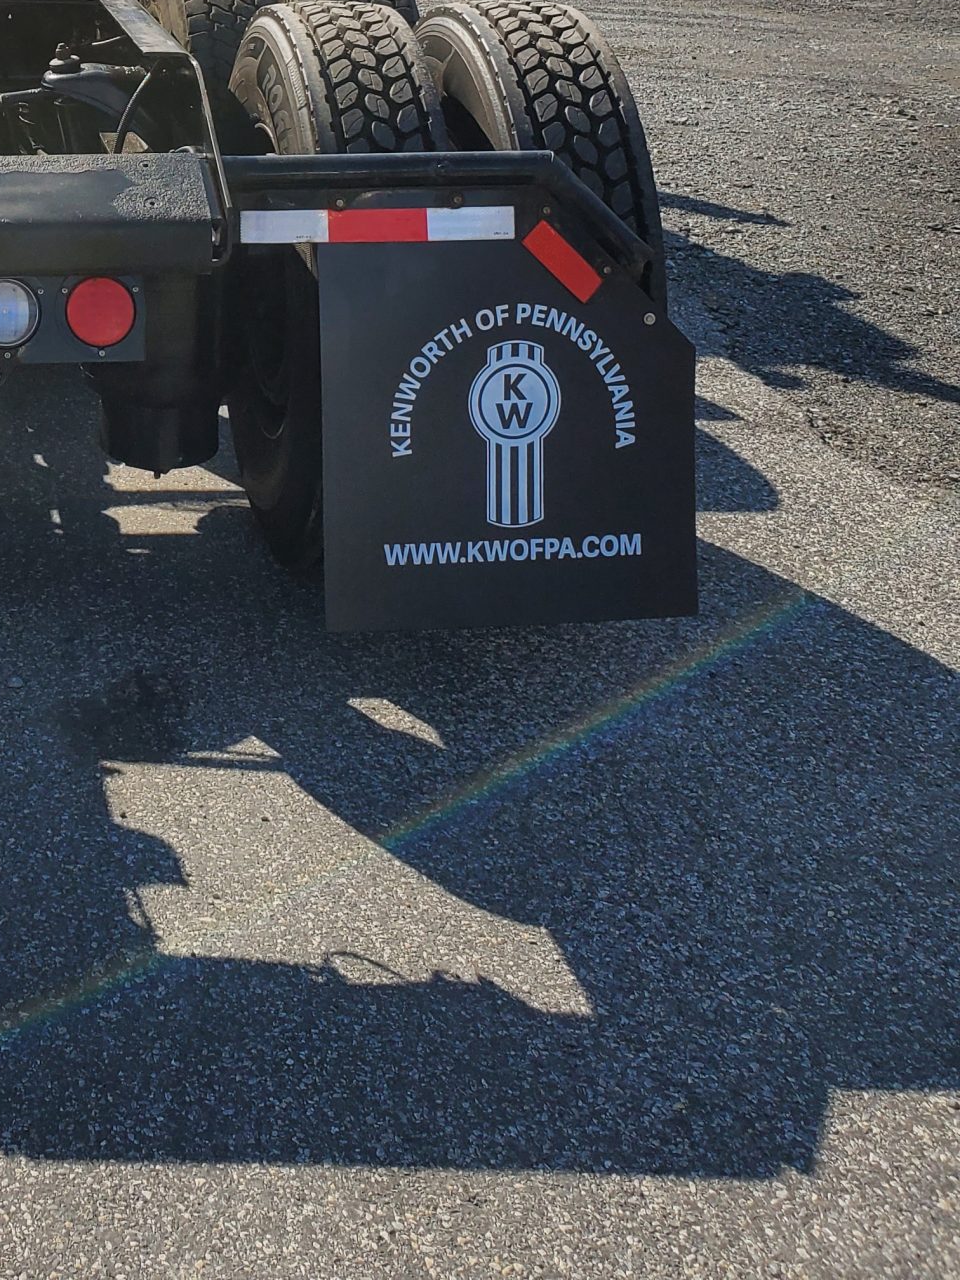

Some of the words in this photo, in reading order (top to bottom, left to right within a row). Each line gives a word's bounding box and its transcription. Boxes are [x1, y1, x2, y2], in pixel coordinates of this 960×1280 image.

[390, 318, 473, 457] KENWORTH
[475, 304, 509, 331] OF
[516, 303, 636, 449] PENNSYLVANIA
[384, 533, 642, 566] WWW.KWOFPA.COM
